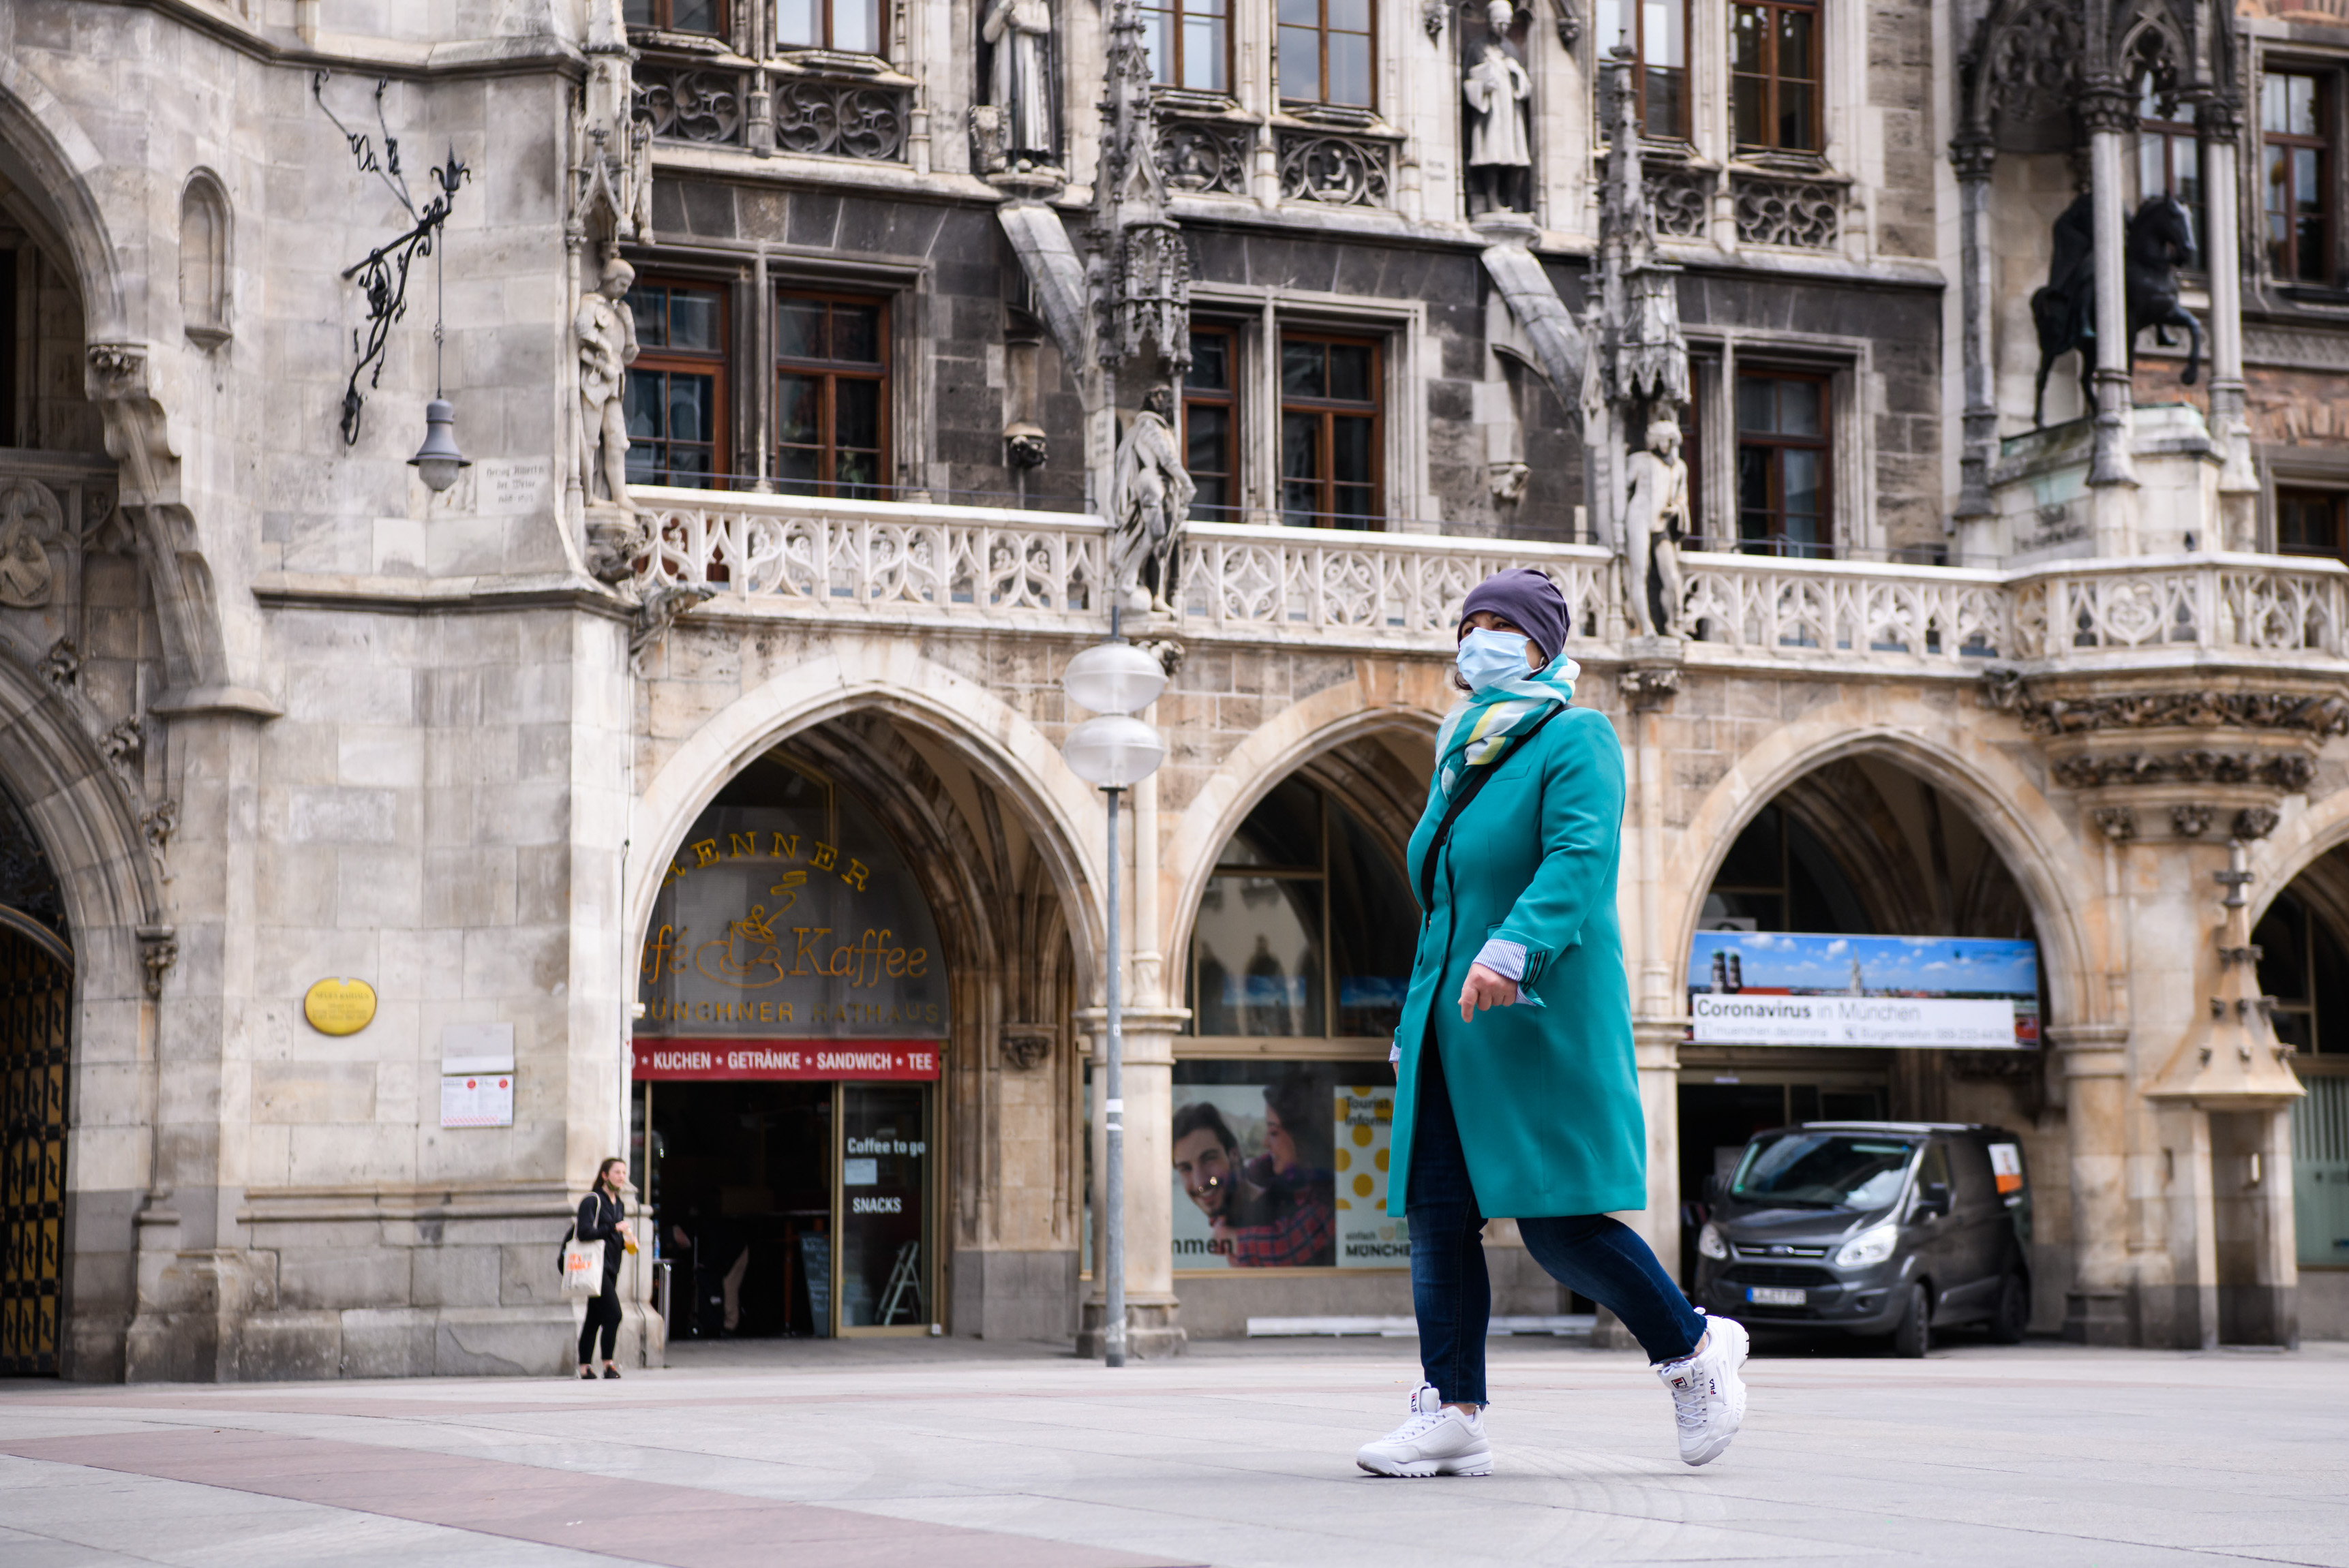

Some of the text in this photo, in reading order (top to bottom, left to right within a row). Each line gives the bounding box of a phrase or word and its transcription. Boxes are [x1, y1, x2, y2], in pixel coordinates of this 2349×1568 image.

[788, 927, 928, 988] Kaffee
[642, 997, 939, 1023] ÜNCHNER RATHAUS
[1697, 998, 1922, 1021] Coronavirus in München
[653, 1051, 711, 1070] KUCHEN
[727, 1047, 801, 1070] GETRÄNKE
[817, 1052, 892, 1070] SANDWICH
[907, 1053, 933, 1071] TEE
[1346, 1095, 1391, 1109] Tourist
[847, 1137, 926, 1158] Coffee to go
[852, 1197, 902, 1214] SNACKS
[1709, 1378, 1717, 1396] FILA
